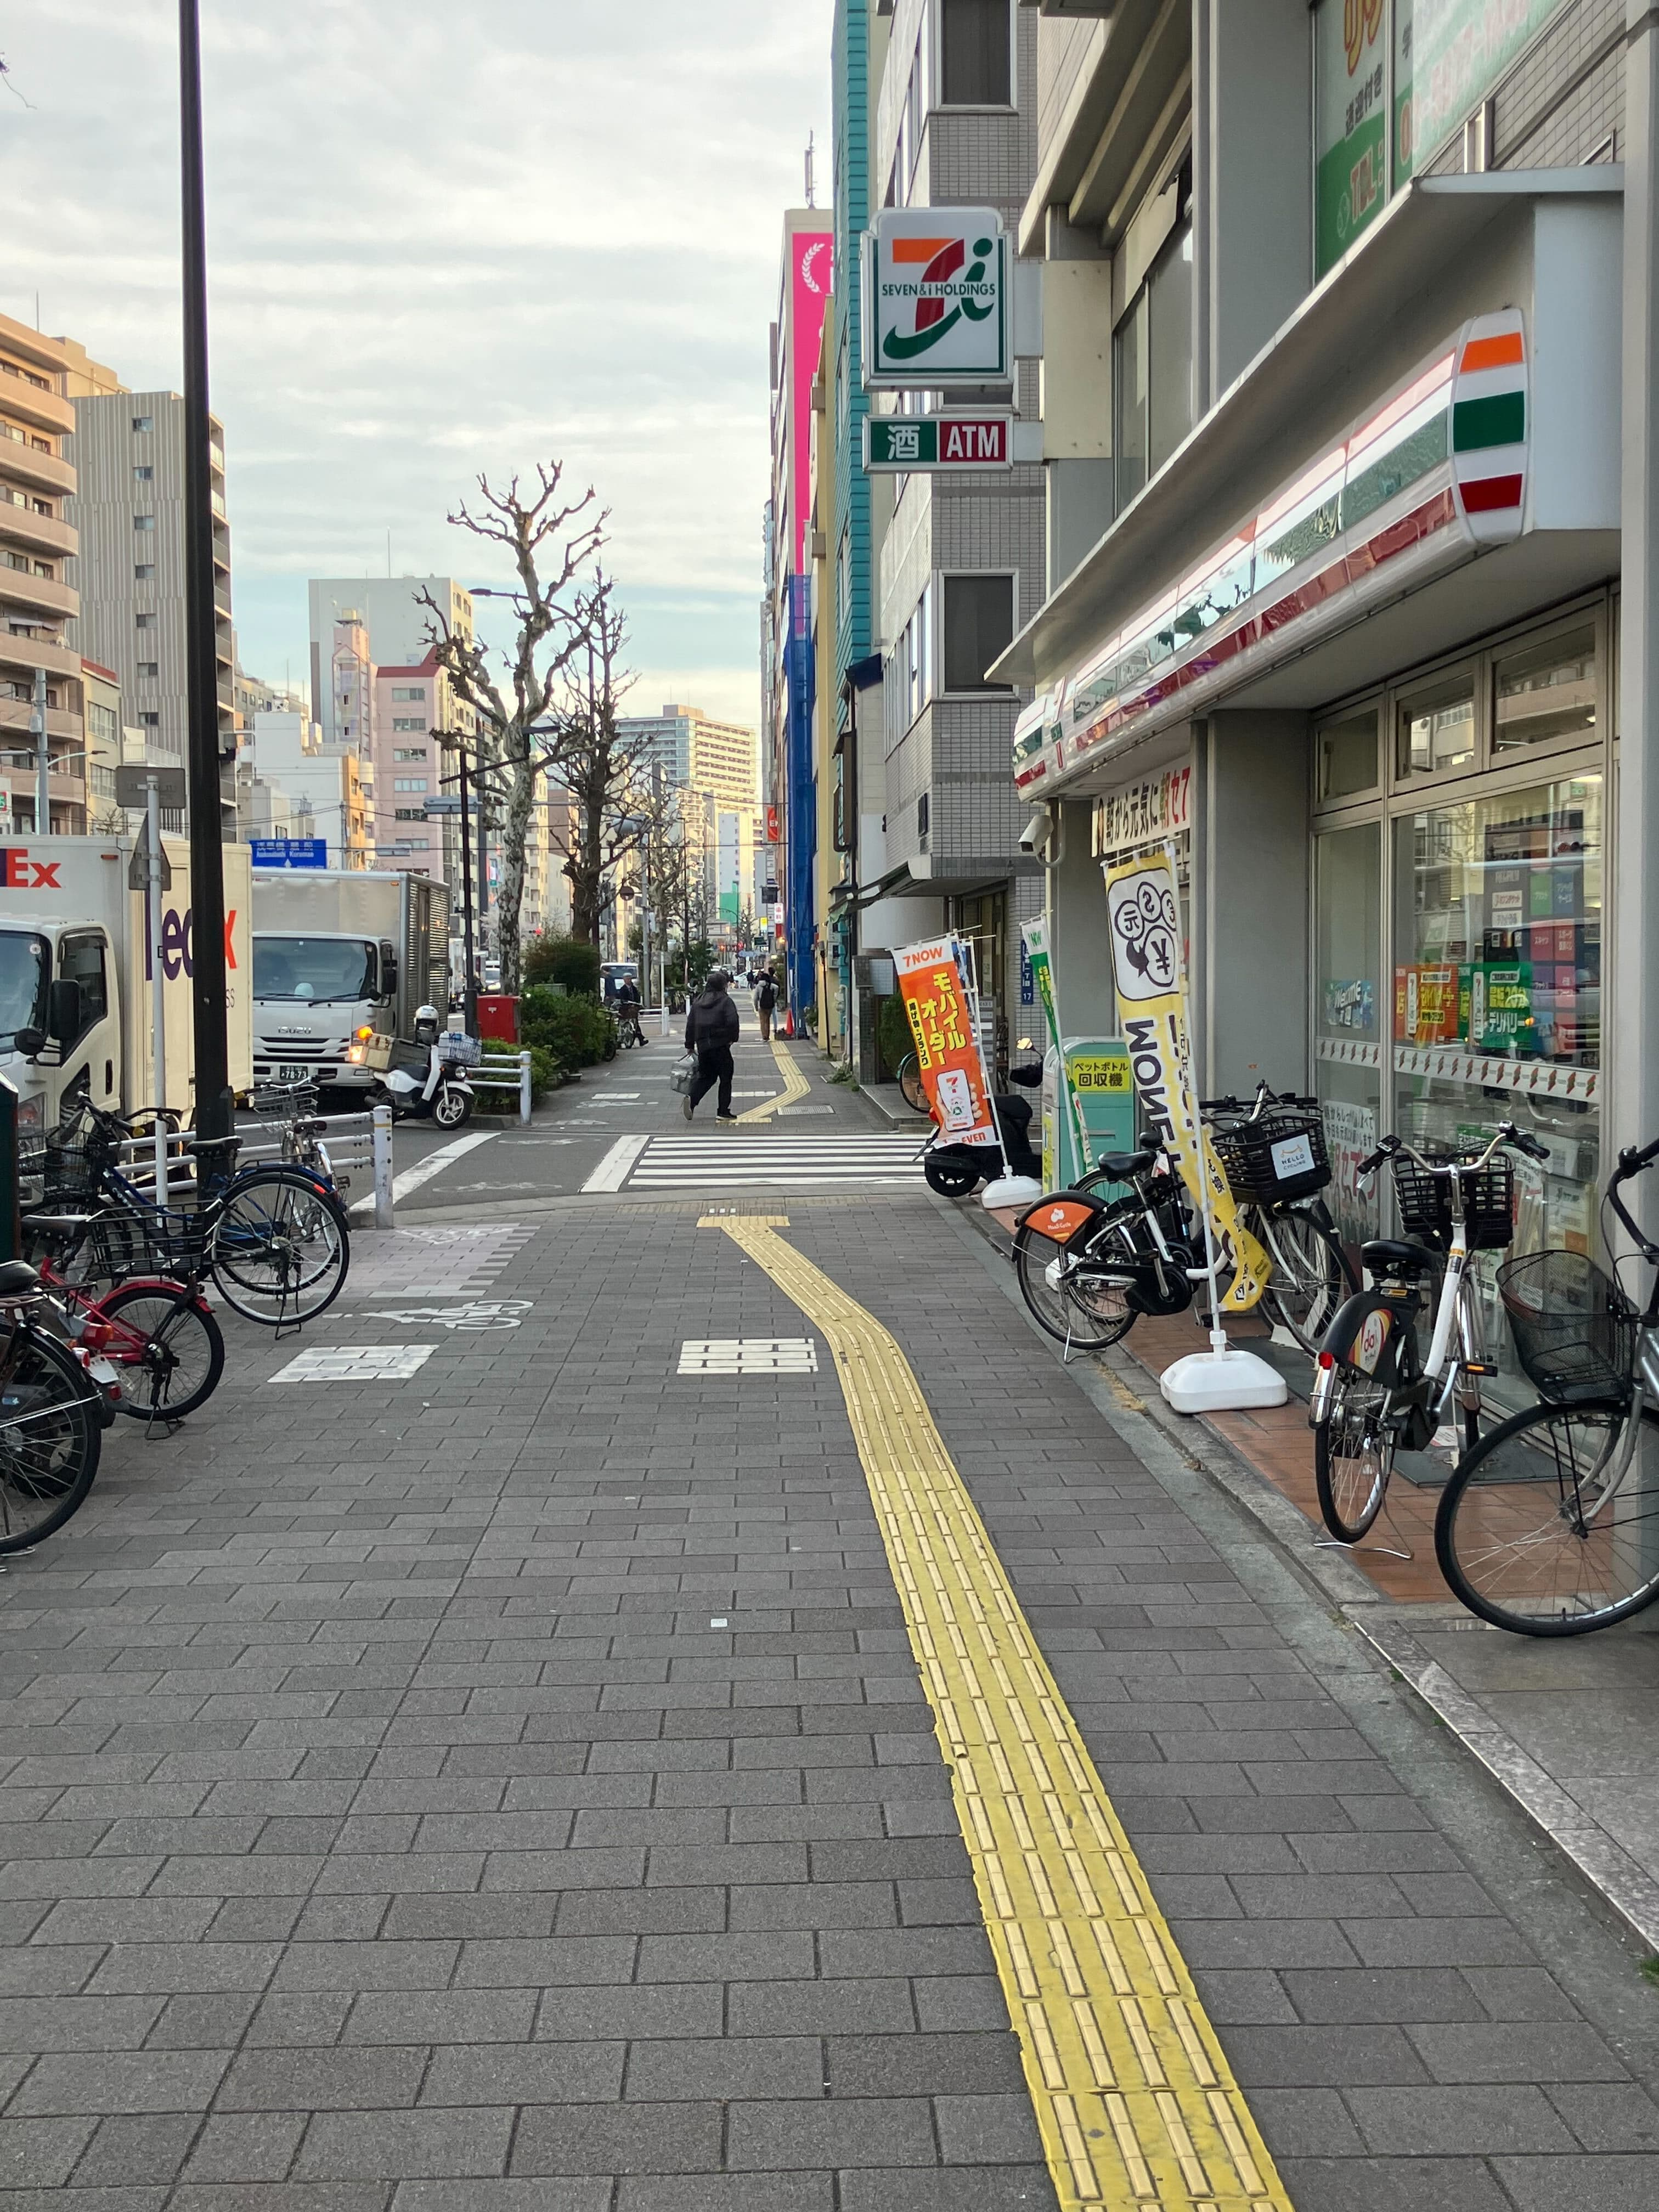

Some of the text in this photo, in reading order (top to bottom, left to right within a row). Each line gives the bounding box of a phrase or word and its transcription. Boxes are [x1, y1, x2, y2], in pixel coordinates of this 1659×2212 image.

[935, 283, 996, 296] HOLDINGS
[888, 424, 921, 460] 酒
[946, 426, 998, 458] ATM
[902, 946, 943, 967] 7NOW
[933, 972, 967, 1051] モバイル
[278, 1026, 312, 1034] ISUZU
[921, 998, 947, 1066] オーダー
[1074, 1062, 1128, 1071] ペットボトル
[1079, 1073, 1123, 1087] 回収機
[1282, 1154, 1305, 1165] HELLO
